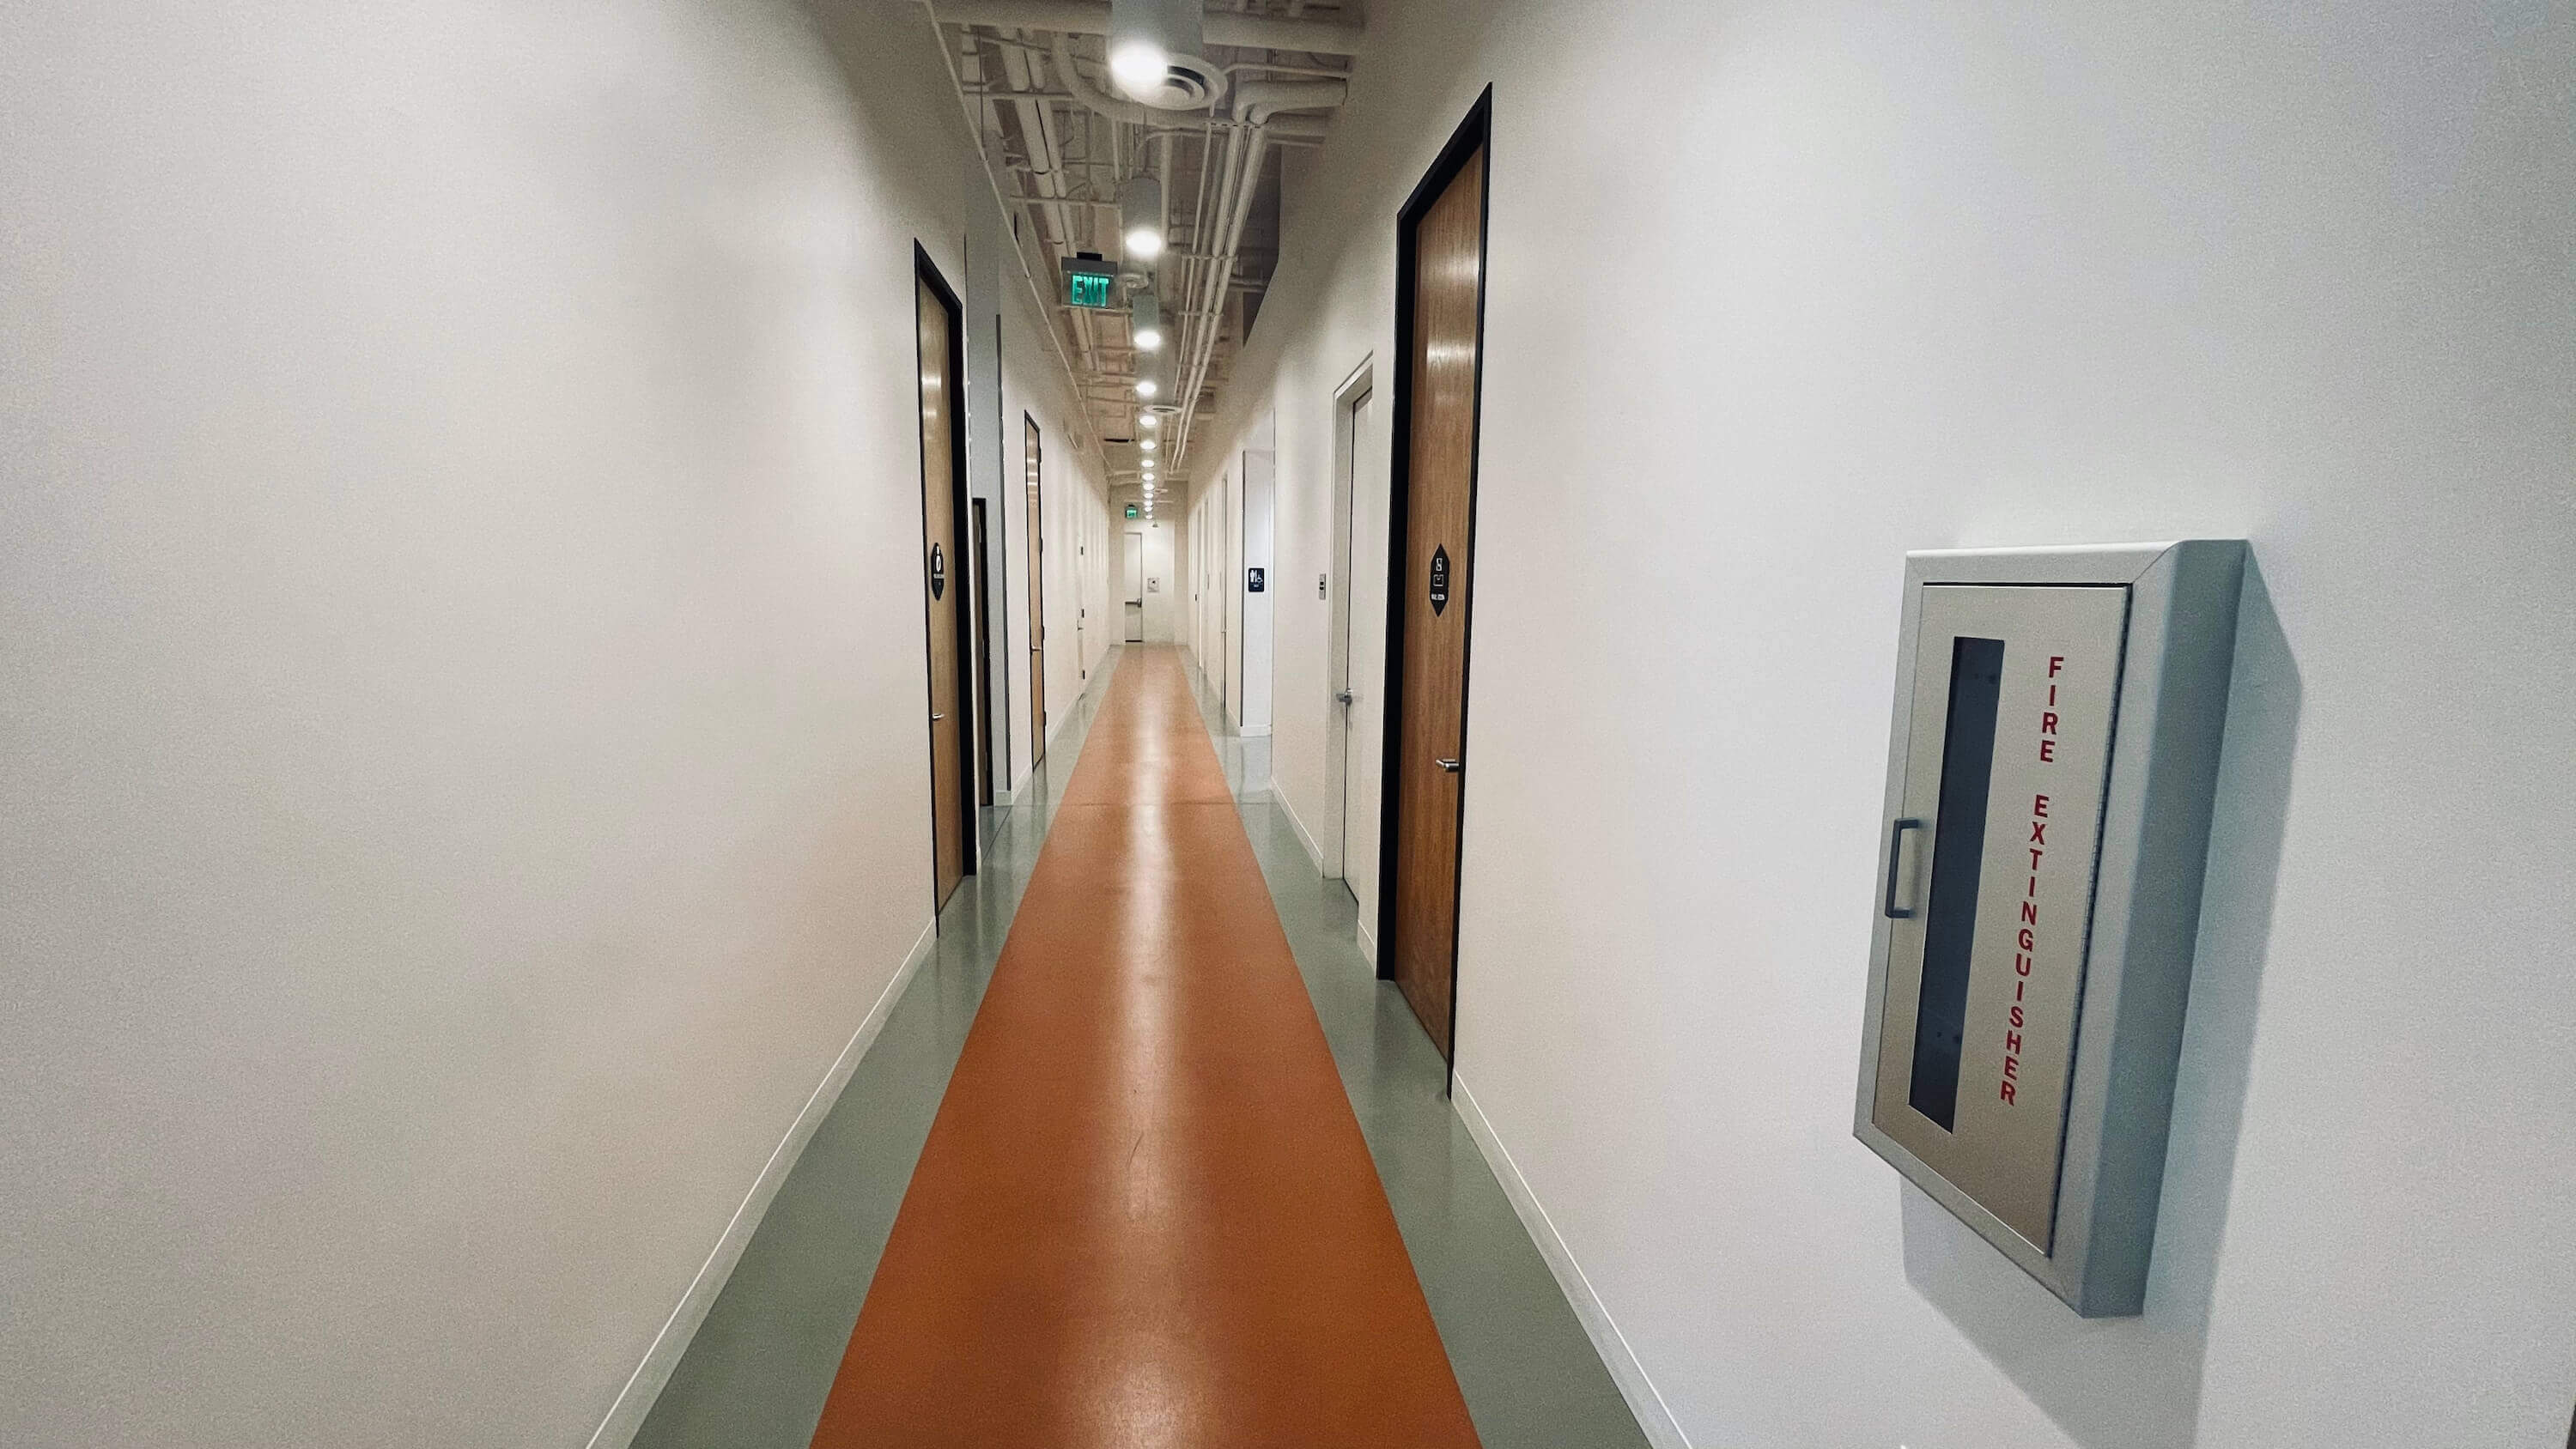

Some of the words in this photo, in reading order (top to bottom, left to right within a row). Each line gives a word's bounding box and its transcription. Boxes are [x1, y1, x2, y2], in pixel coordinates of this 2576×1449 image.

[1072, 275, 1109, 306] EXIT
[2039, 656, 2063, 763] FIRE
[2000, 795, 2049, 1106] EXTINGUISHER
